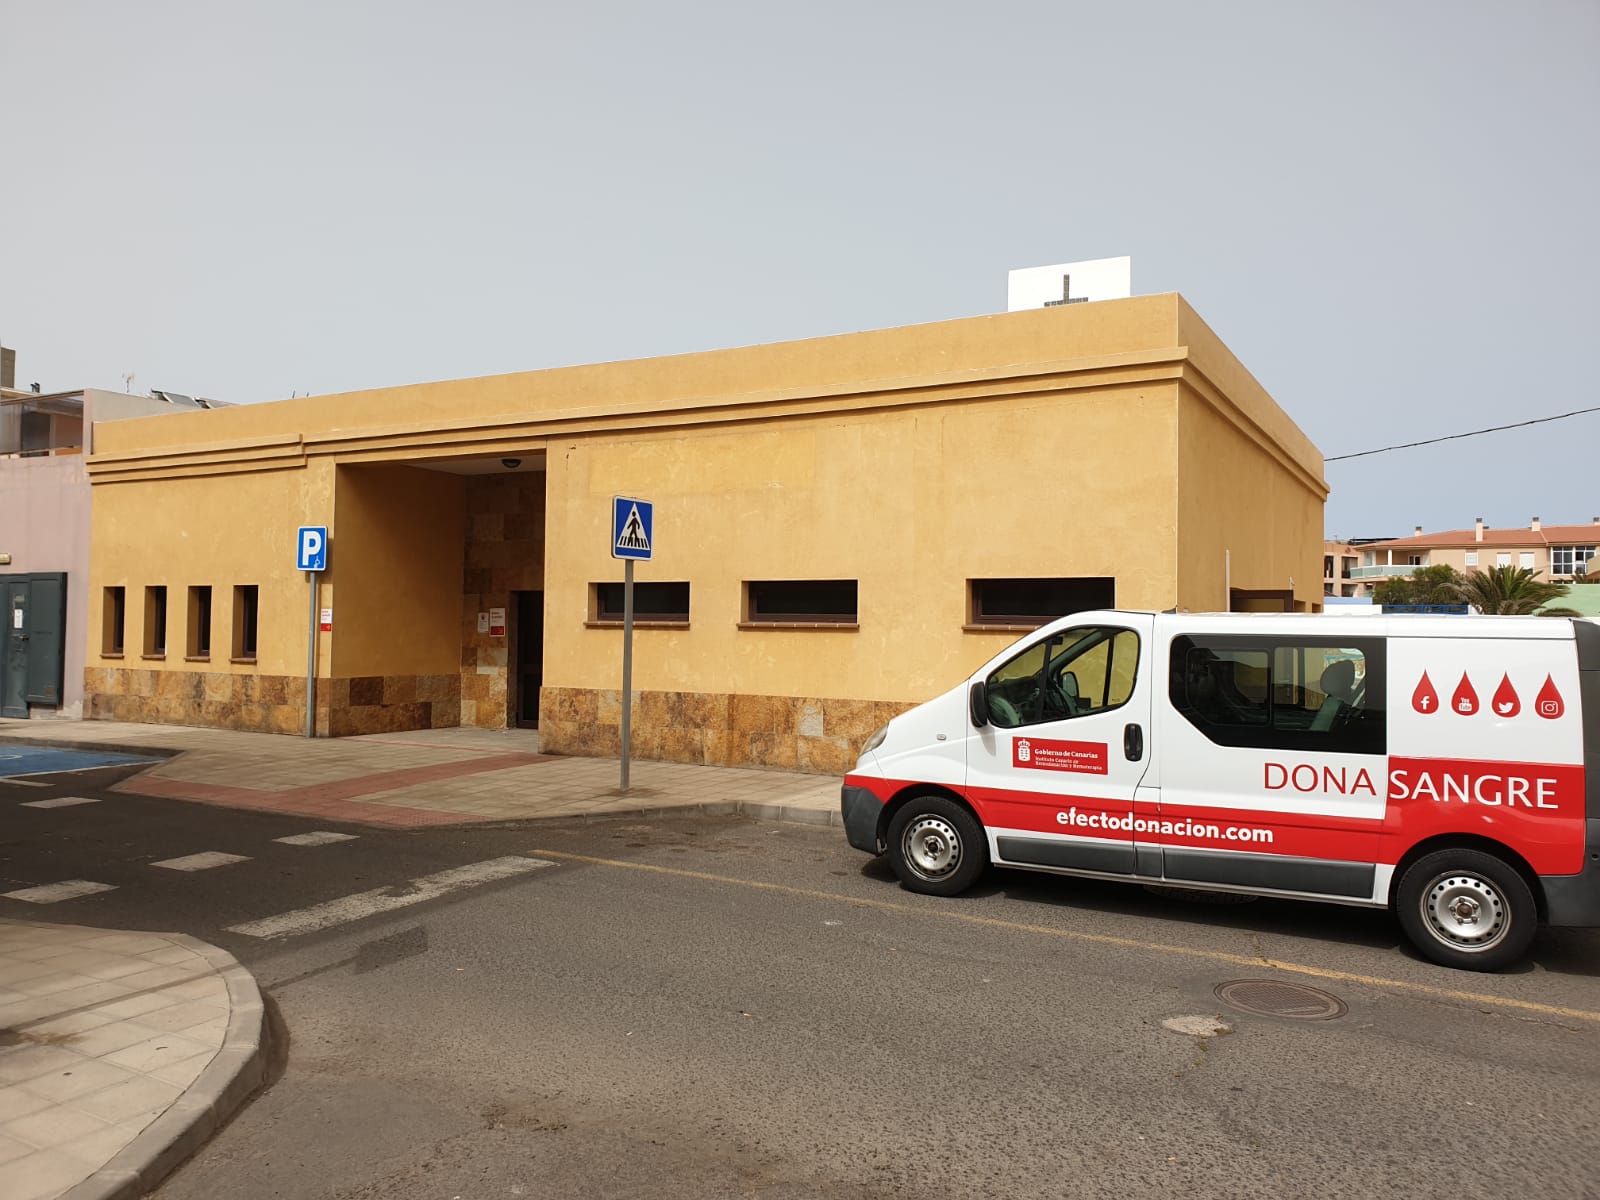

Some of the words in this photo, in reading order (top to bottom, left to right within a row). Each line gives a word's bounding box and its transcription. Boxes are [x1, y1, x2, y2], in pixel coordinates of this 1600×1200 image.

[302, 531, 322, 566] P
[1034, 748, 1063, 757] Gobierno
[1071, 751, 1098, 759] Canarias
[1264, 762, 1376, 796] DONA
[1389, 769, 1559, 809] SANGRE
[1056, 806, 1273, 843] efectodonacion.com
